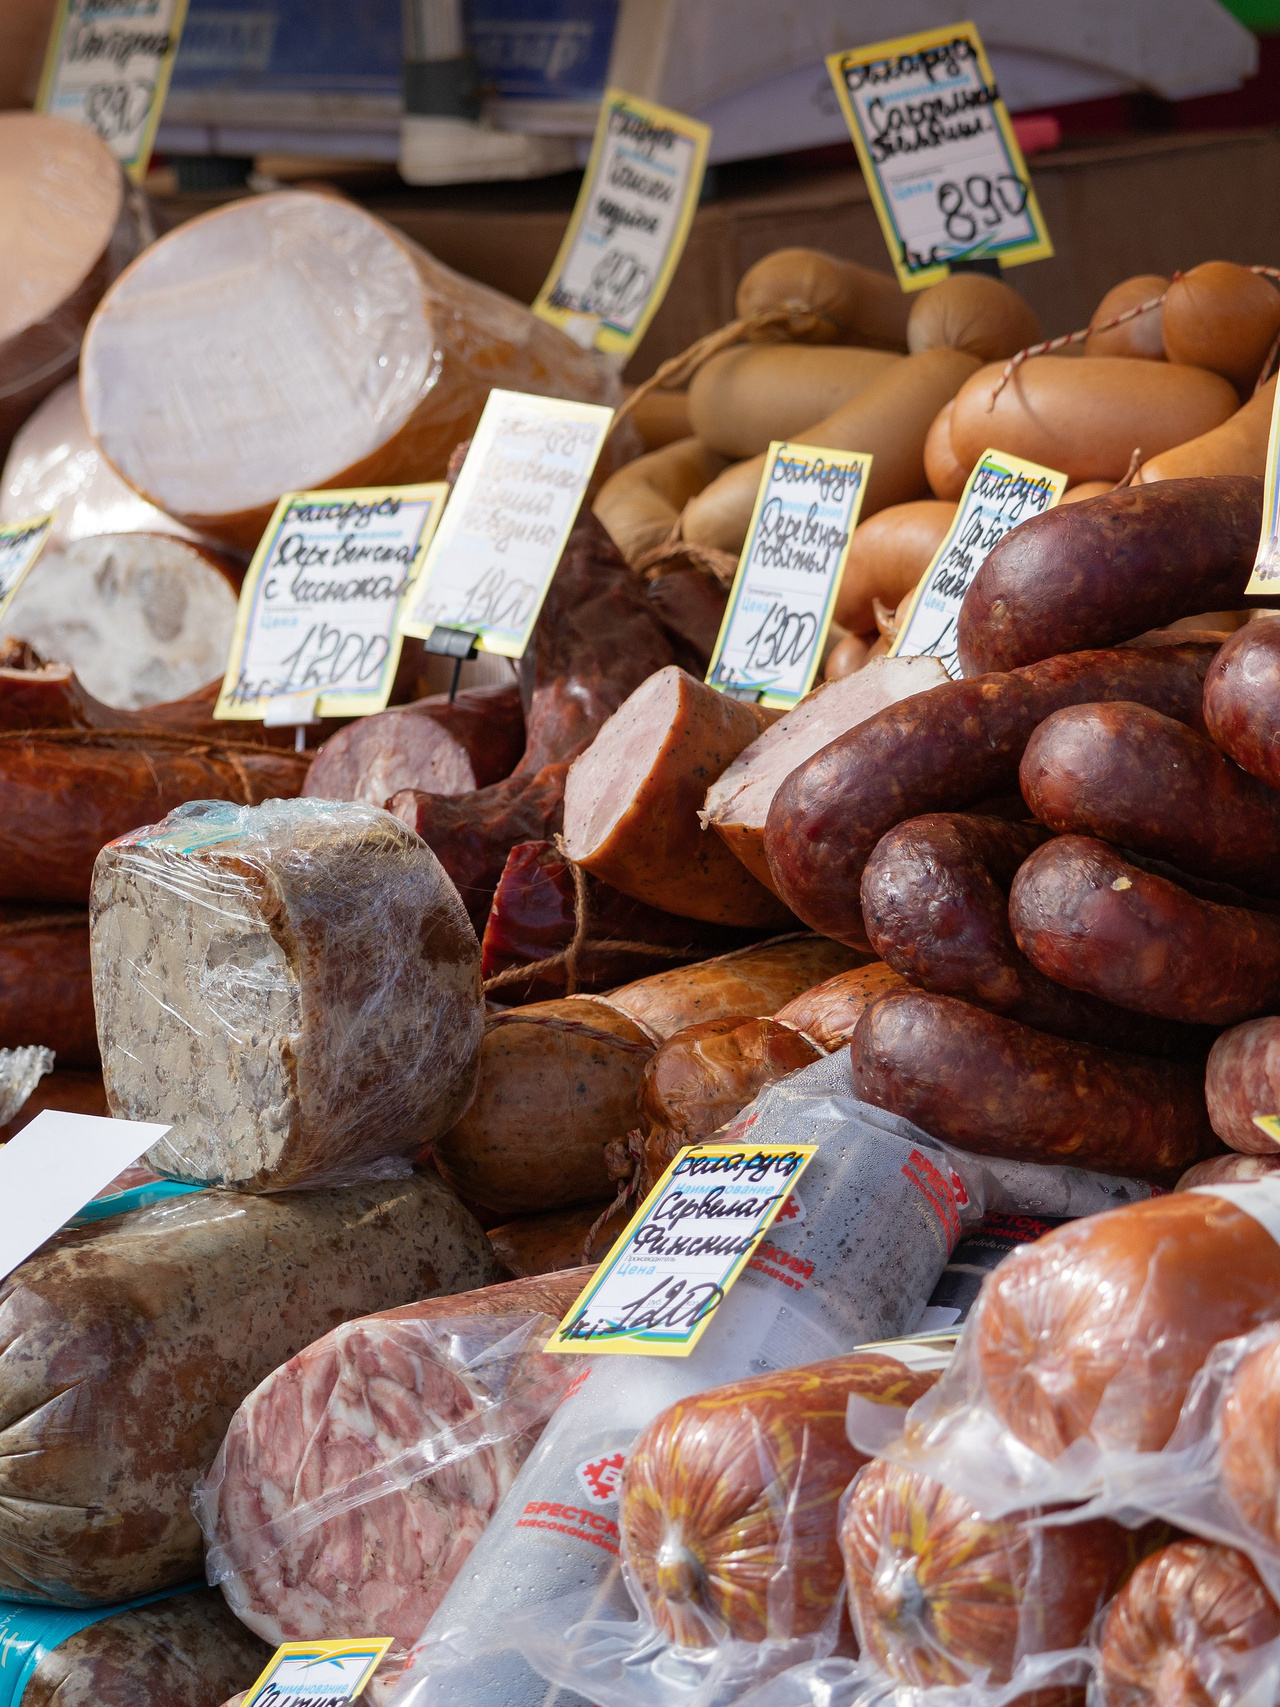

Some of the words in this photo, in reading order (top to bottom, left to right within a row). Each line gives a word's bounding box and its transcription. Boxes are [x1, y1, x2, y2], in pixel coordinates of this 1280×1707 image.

[937, 175, 1028, 242] 890
[671, 1146, 804, 1182] Беларусь
[652, 1185, 784, 1231] Сервелат
[633, 1224, 766, 1257] Финский
[616, 1262, 657, 1276] Цена
[523, 1501, 621, 1541] БРЕСТСК
